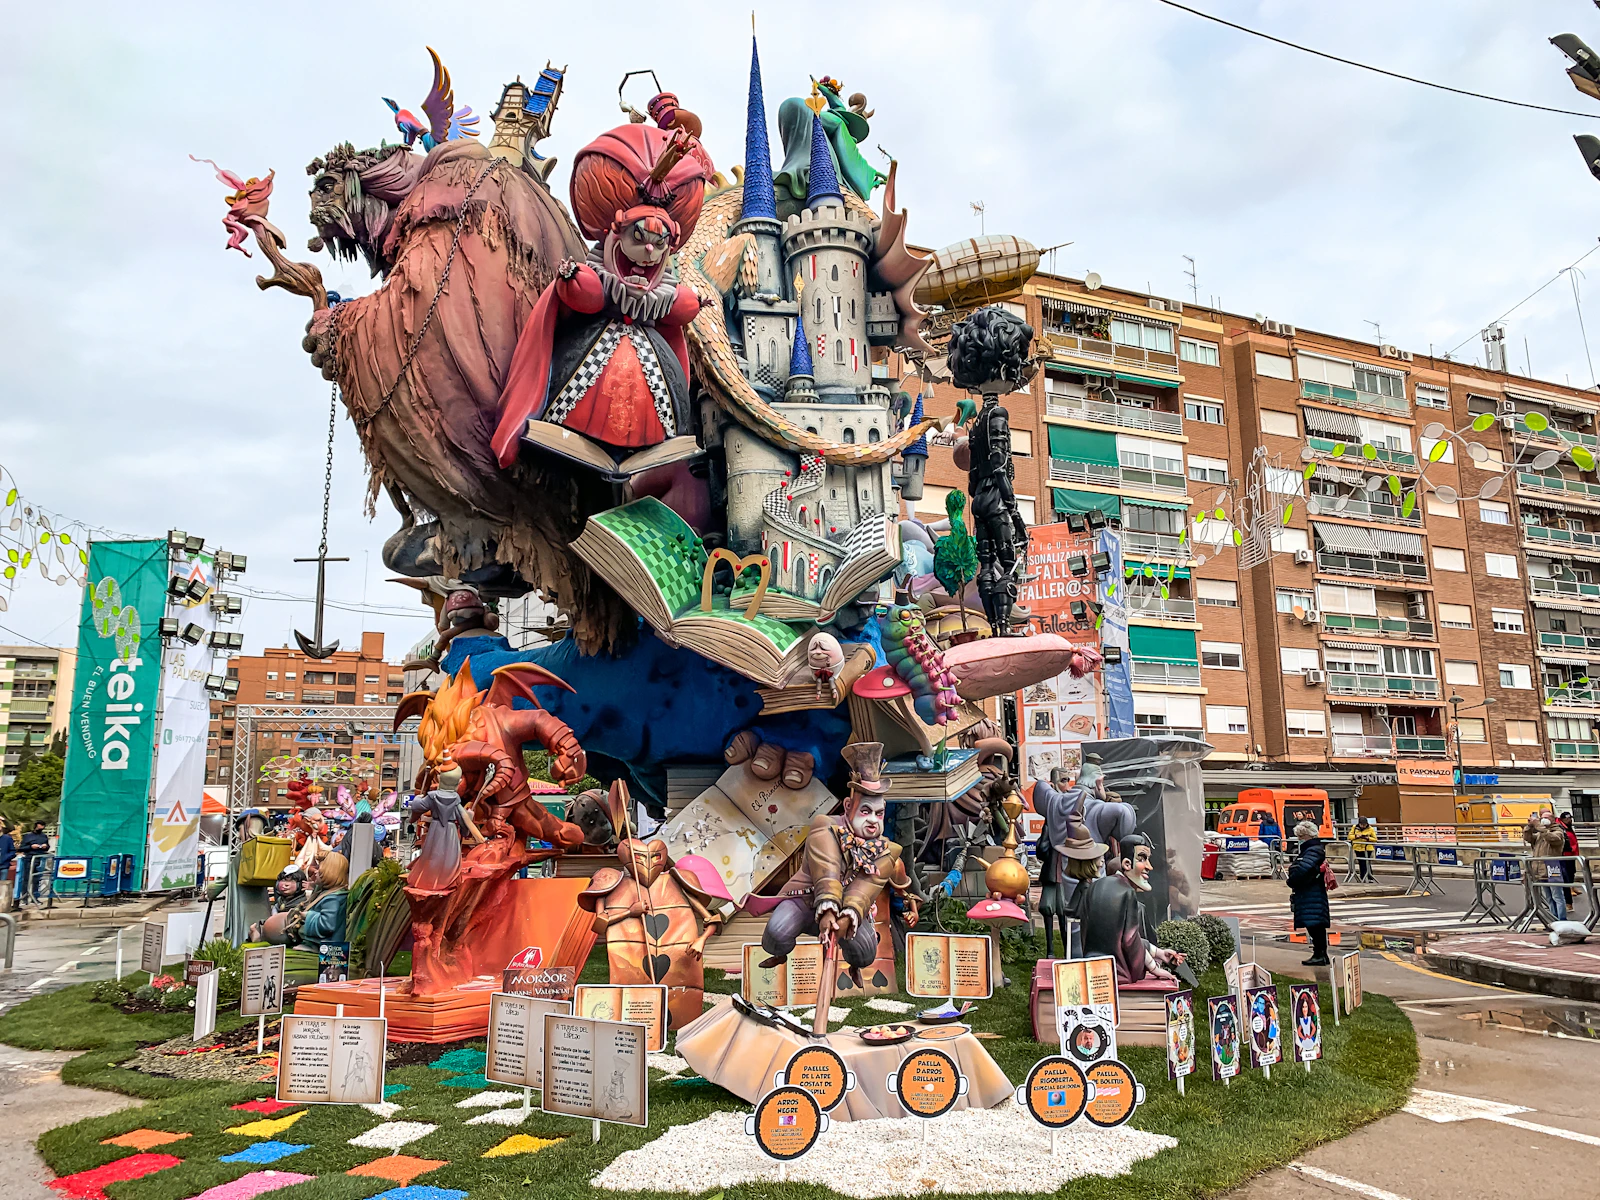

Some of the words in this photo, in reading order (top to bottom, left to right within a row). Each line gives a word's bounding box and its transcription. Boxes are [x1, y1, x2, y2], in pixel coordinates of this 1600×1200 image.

[168, 652, 186, 667] LAS
[92, 665, 104, 676] EL
[172, 666, 211, 682] PALMERA
[81, 680, 97, 709] BUEN
[100, 657, 144, 770] teika
[80, 712, 97, 759] VENDING
[1399, 767, 1408, 775] EL
[1409, 768, 1451, 776] PAPONAZO
[751, 800, 763, 812] El
[759, 779, 785, 803] Princip
[510, 969, 567, 985] MORDOR
[912, 1075, 945, 1083] BRILLANTE
[1040, 1076, 1074, 1084] RIGOBERTA
